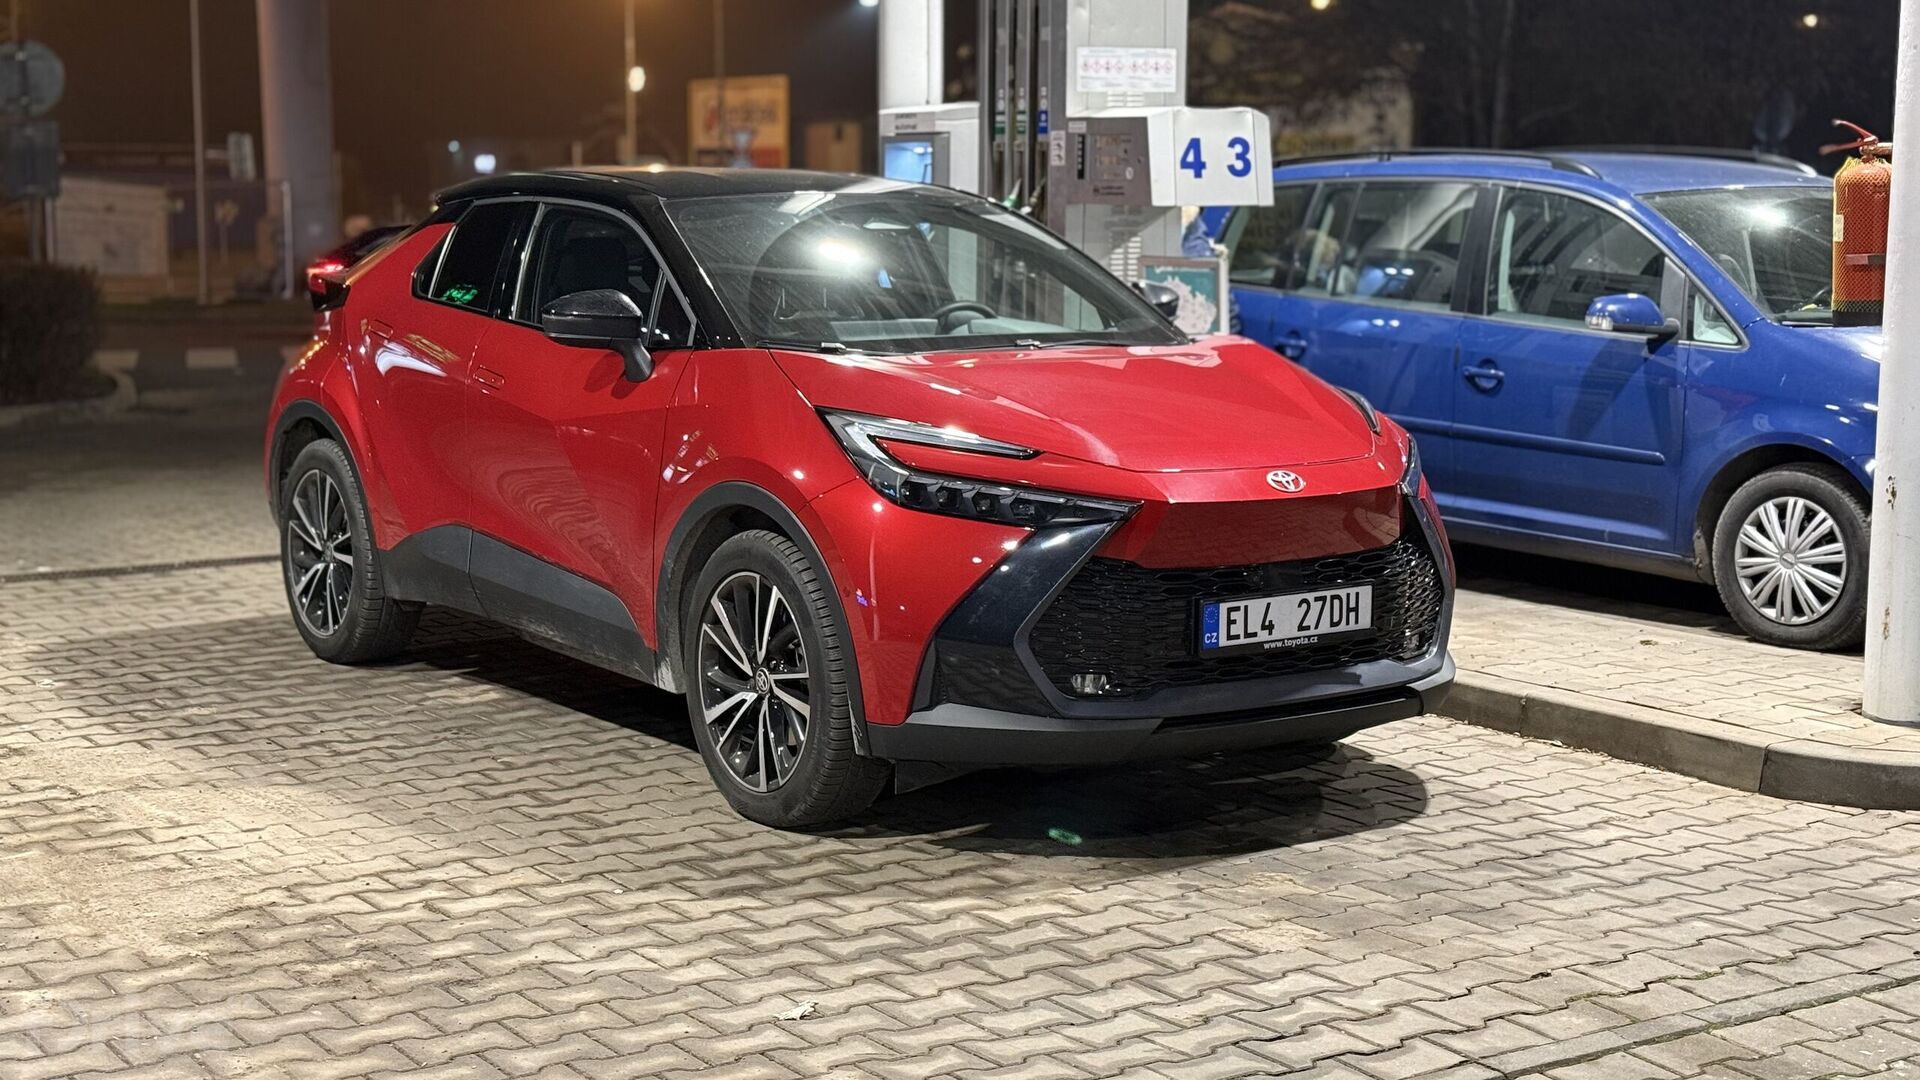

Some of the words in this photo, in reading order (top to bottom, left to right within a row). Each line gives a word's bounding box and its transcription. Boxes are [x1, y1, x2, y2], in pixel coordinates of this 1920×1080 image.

[1180, 138, 1206, 179] 4
[1226, 137, 1252, 178] 3
[1226, 602, 1275, 641] EL4
[1297, 591, 1360, 633] 27DH
[1204, 632, 1218, 644] CZ
[1263, 636, 1319, 650] www.toyota.cz
